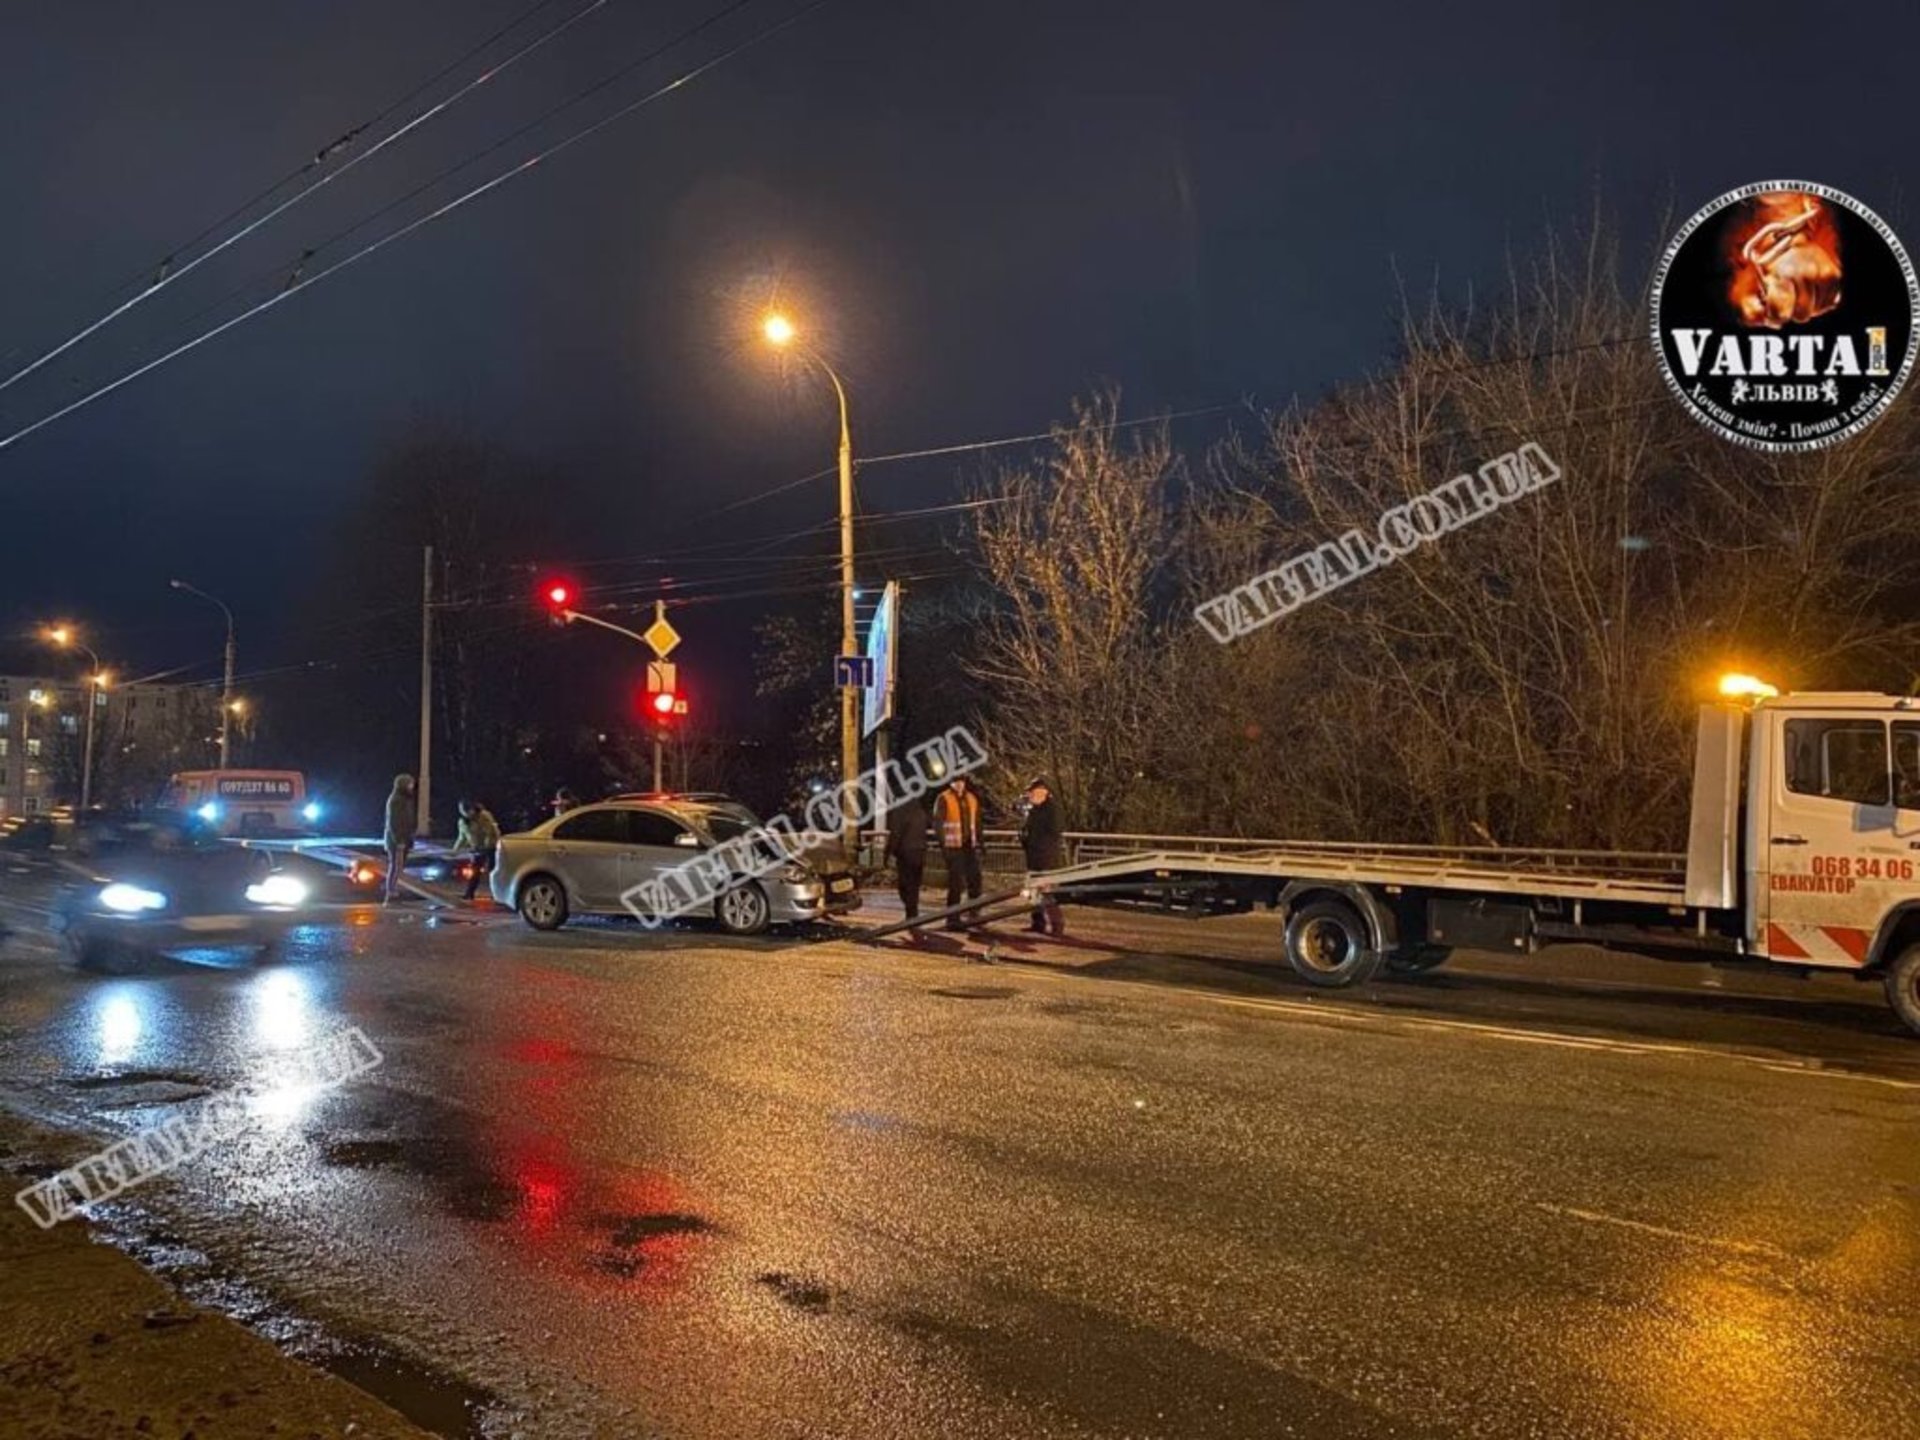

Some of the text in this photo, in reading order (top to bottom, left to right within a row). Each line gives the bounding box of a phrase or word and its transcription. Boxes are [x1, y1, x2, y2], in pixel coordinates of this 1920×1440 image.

[1812, 856, 1913, 880] 068 34 06
[1770, 874, 1856, 894] ЕВАКУАТОР
